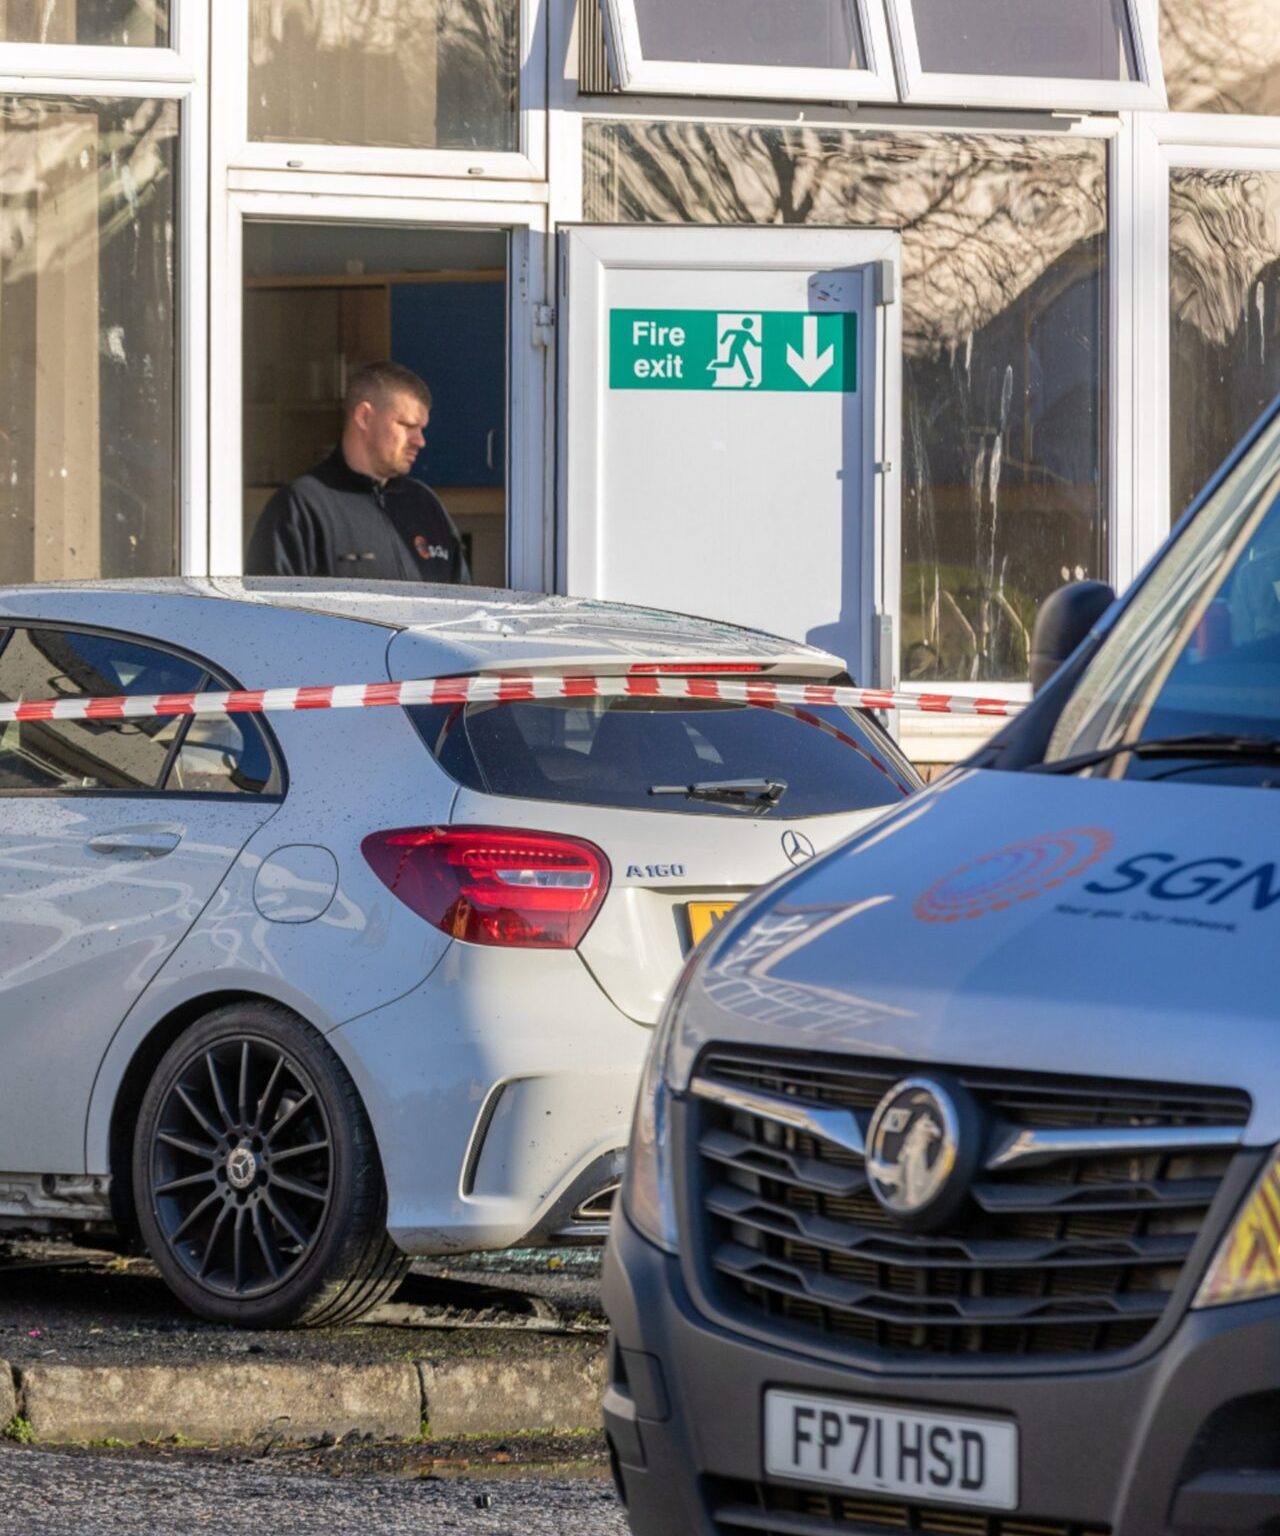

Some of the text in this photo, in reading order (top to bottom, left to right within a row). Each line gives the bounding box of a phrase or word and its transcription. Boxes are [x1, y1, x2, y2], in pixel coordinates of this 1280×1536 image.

[632, 321, 686, 346] Fire
[633, 354, 683, 378] exit
[793, 1405, 986, 1492] FP71 HSD
